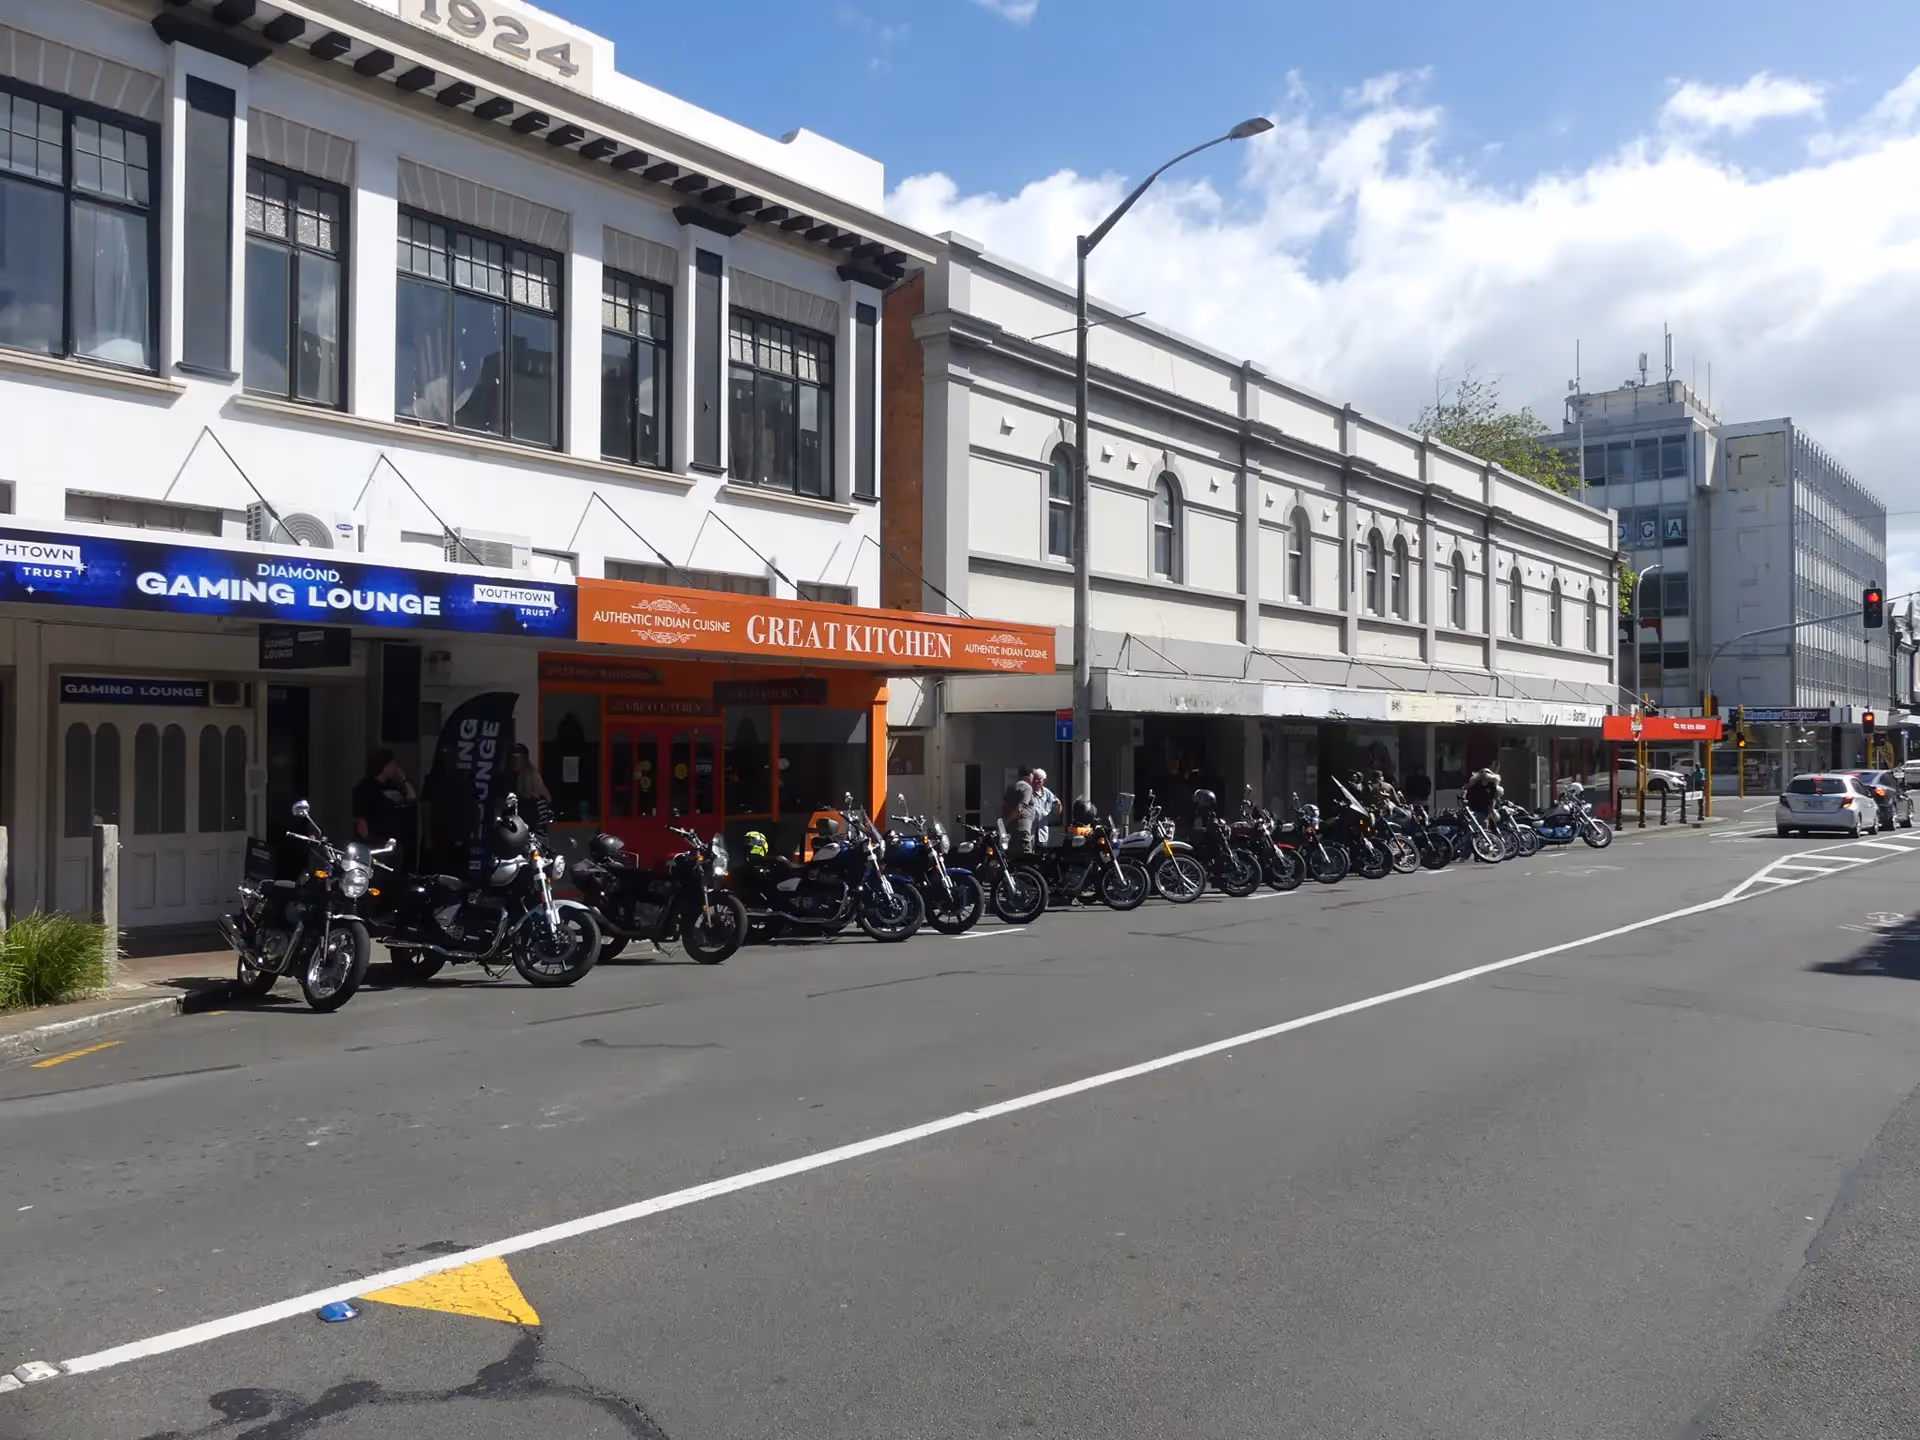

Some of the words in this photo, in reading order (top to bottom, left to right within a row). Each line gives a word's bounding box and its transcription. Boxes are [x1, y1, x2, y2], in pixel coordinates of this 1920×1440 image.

[420, 0, 580, 77] 1924
[22, 567, 73, 579] TRUST
[257, 563, 340, 583] DIAMOND
[136, 571, 295, 605] GAMING
[308, 585, 441, 616] LOUNGE
[479, 587, 551, 602] YOUTHTOWN
[520, 608, 550, 617] TRUST
[593, 610, 652, 626] AUTHENTIC
[655, 615, 690, 629] INDIAN
[693, 619, 730, 632] CUISINE
[746, 614, 840, 650] GREAT
[845, 623, 952, 659] KITCHEN
[964, 644, 1000, 655] AUTHENTIC
[1001, 646, 1023, 657] INDIAN
[1024, 648, 1048, 659] CUISINE
[64, 684, 134, 695] GAMING
[140, 686, 205, 698] LOUNGE
